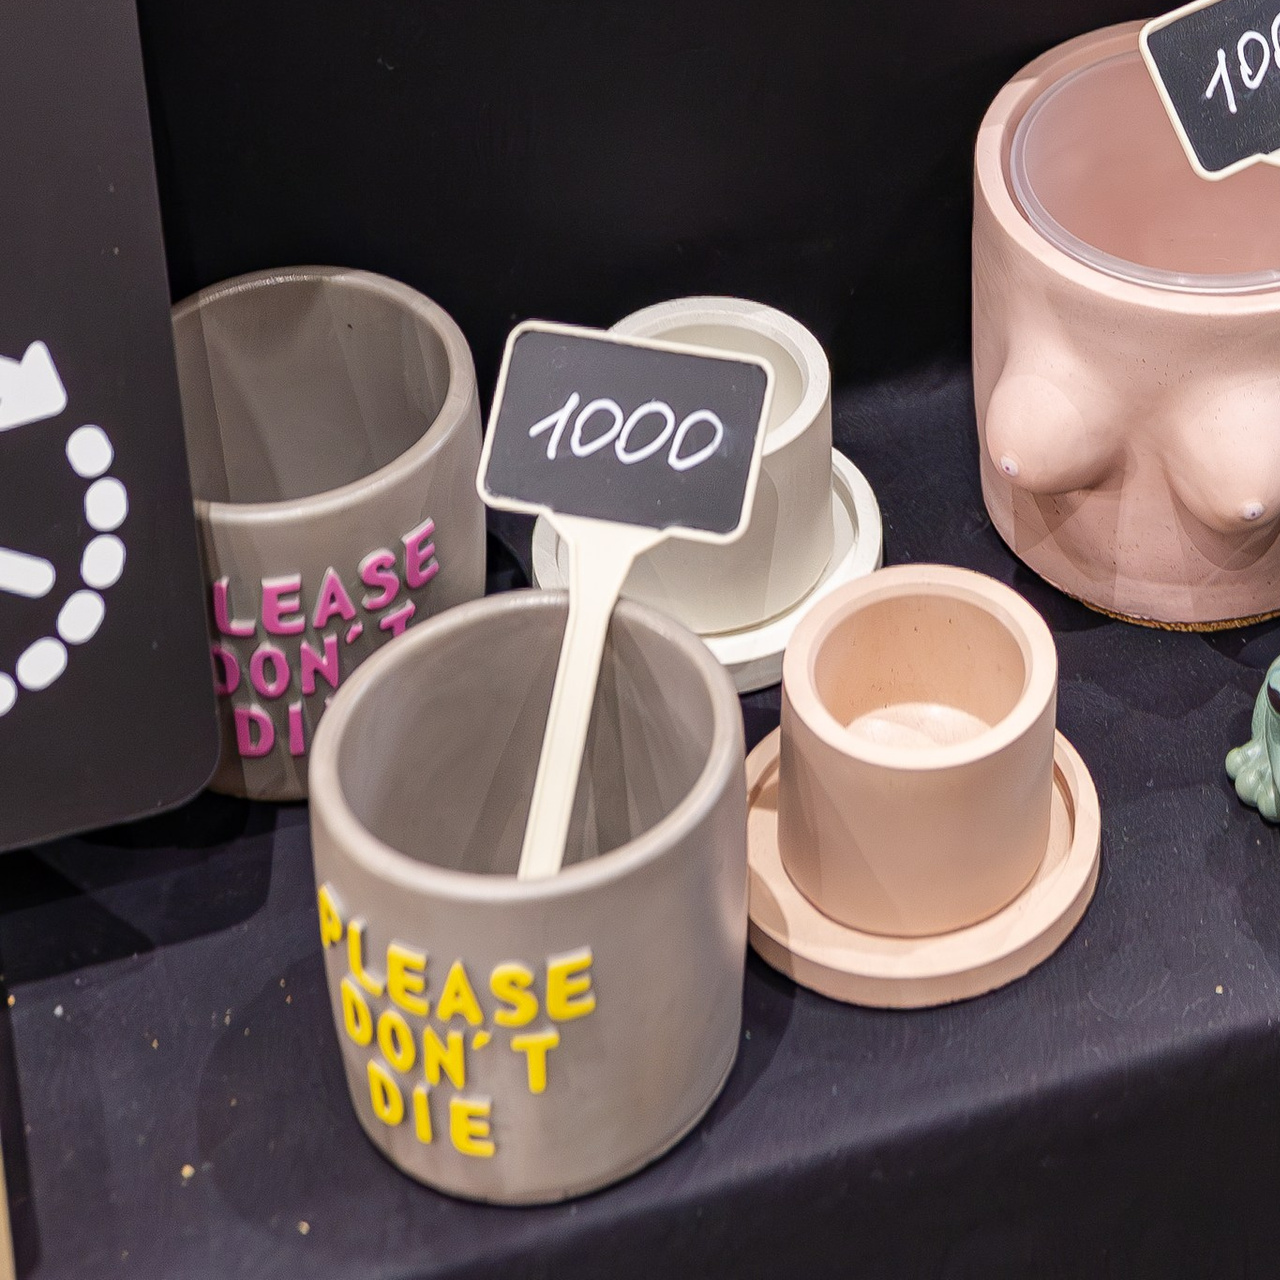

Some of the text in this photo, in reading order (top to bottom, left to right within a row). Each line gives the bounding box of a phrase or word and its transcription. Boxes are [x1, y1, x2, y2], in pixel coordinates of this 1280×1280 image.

[528, 391, 725, 472] 1000
[213, 518, 440, 637] LEASE
[317, 880, 597, 1027] PLEASE
[340, 976, 561, 1095] DON'T
[366, 1057, 496, 1159] DIE
